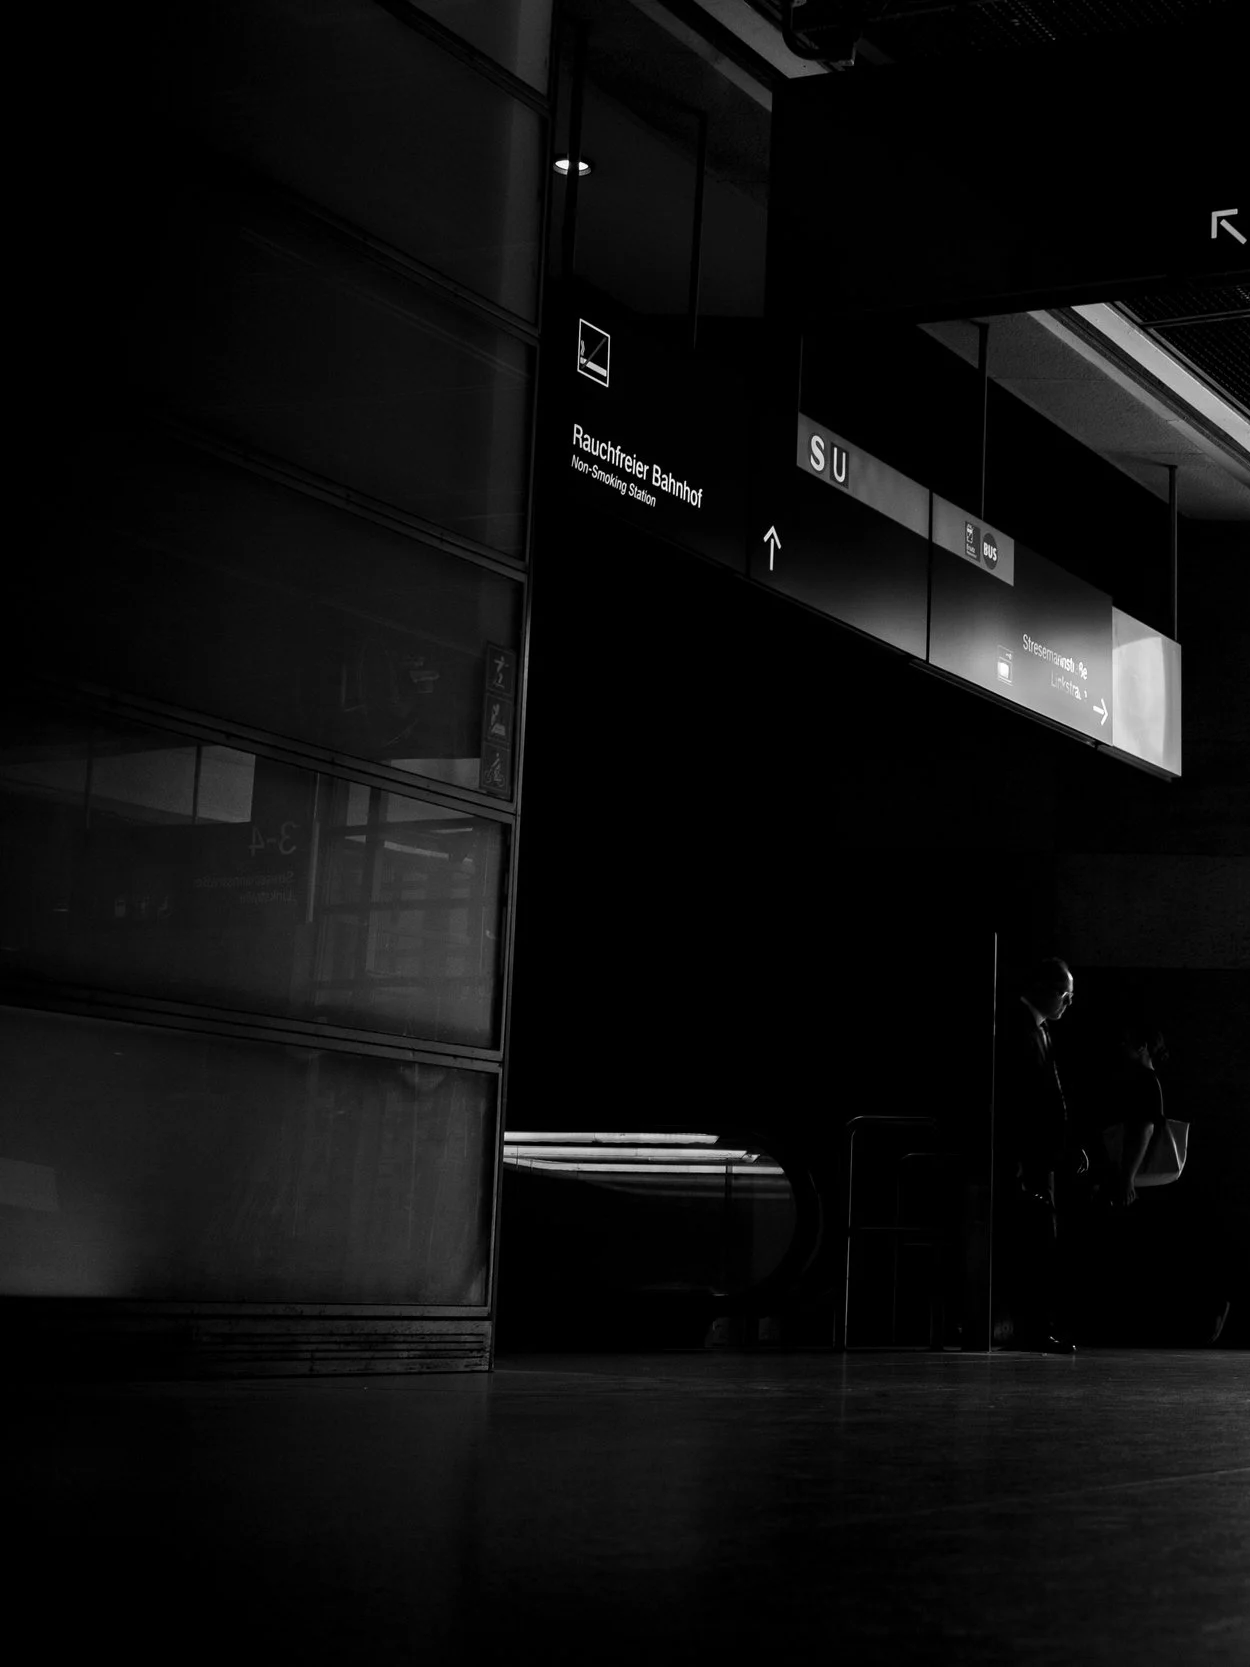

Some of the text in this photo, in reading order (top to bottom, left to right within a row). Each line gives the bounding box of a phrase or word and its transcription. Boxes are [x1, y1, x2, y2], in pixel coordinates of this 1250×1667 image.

[571, 454, 657, 508] Non-Smoking Station
[572, 423, 703, 508] Rauchfreier Bahnhof
[810, 435, 846, 483] S U
[983, 541, 997, 562] BUS
[1022, 633, 1088, 681] Stresemannstrße
